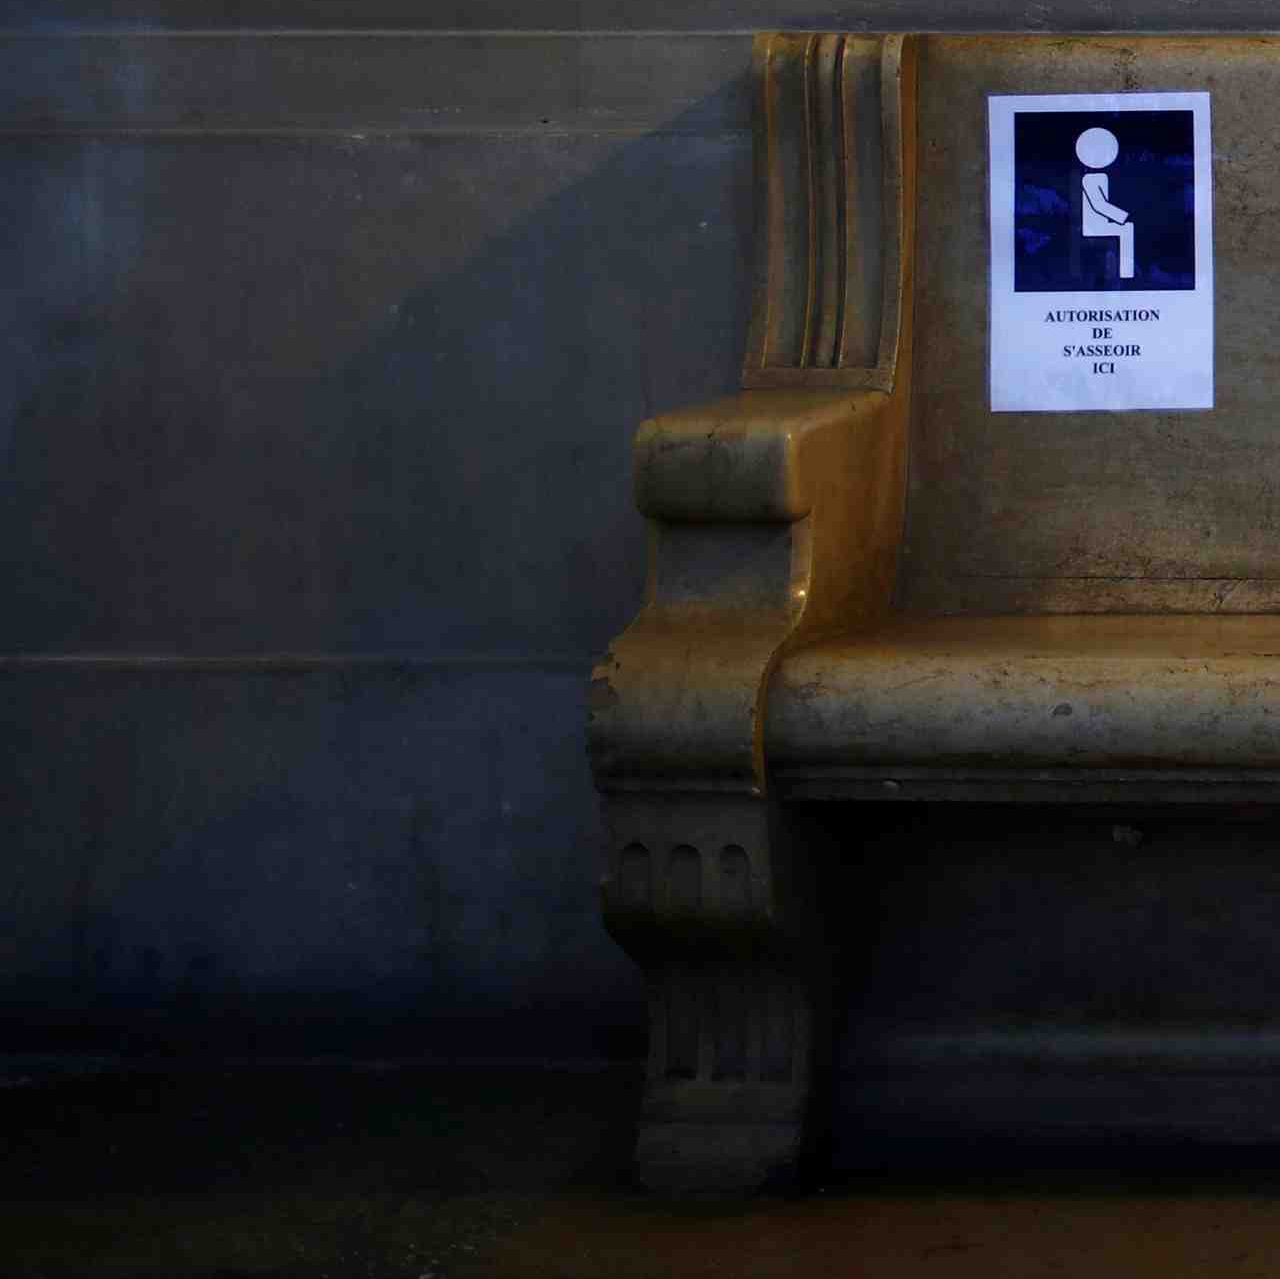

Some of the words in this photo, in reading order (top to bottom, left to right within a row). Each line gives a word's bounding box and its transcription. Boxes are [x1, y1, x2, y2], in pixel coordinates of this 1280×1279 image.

[1043, 309, 1161, 323] AUTORISATION
[1092, 327, 1113, 339] DE
[1063, 344, 1142, 357] S'ASSEOIR
[1093, 362, 1115, 374] ICI
